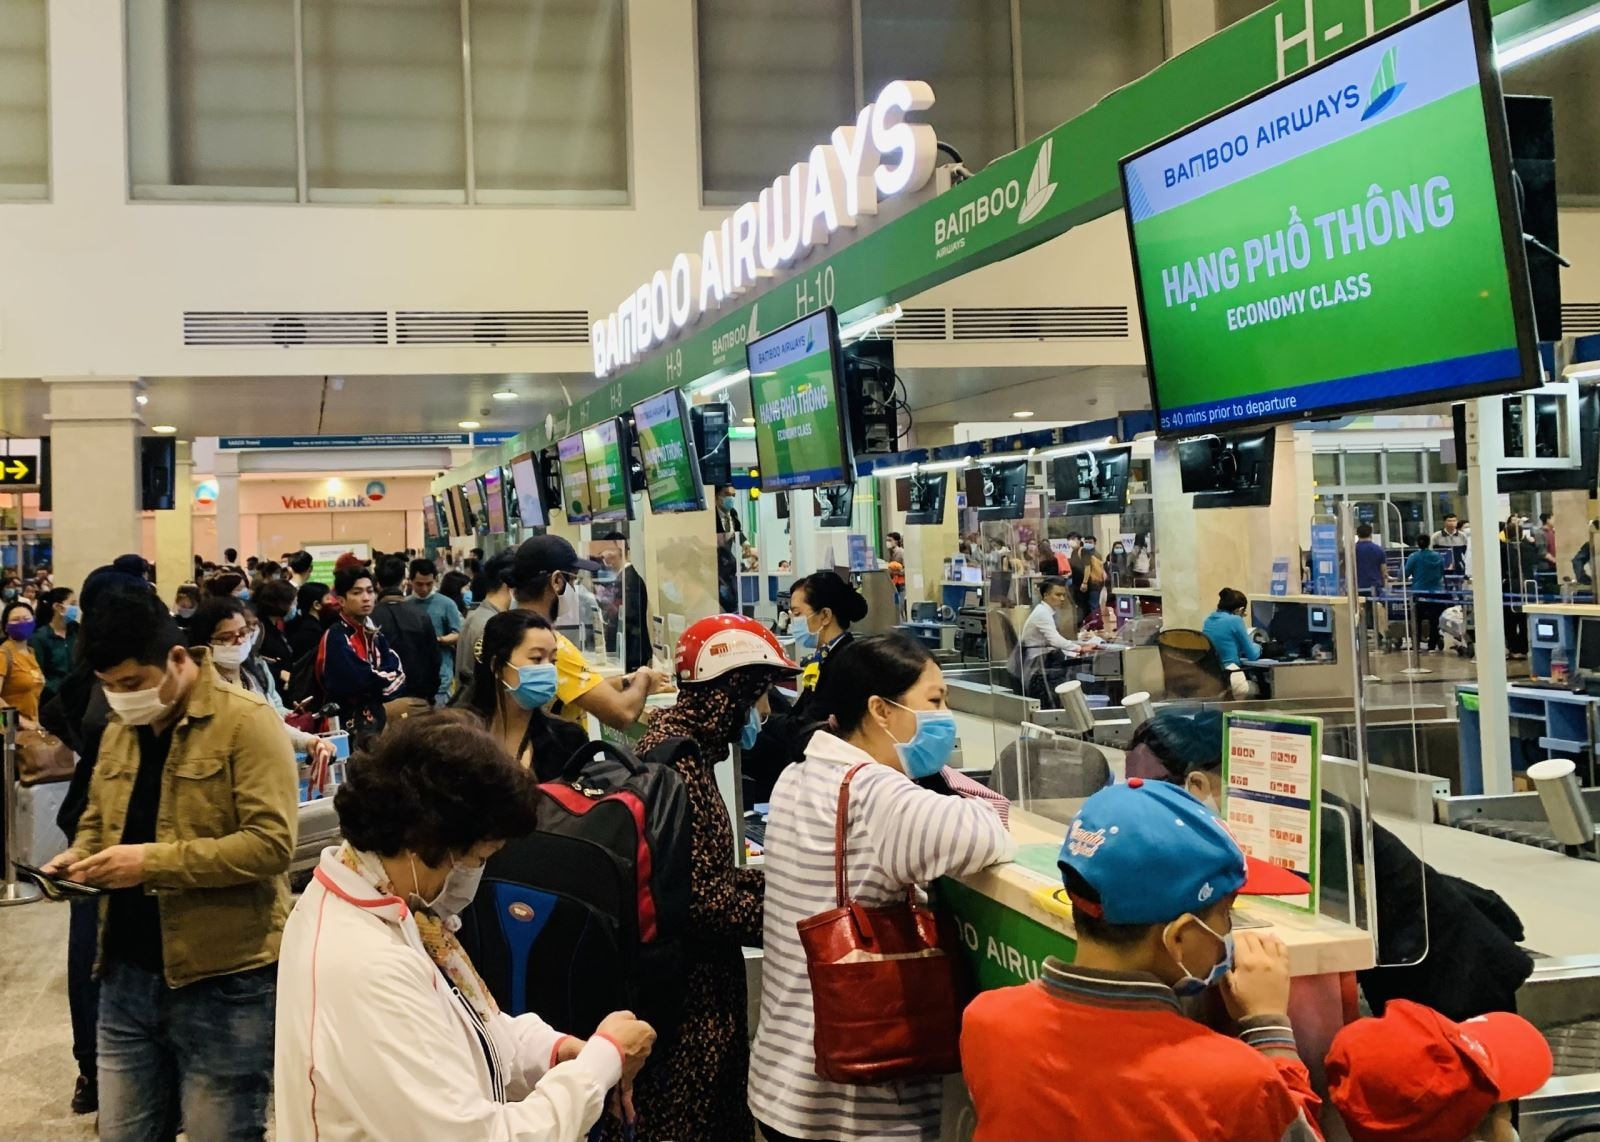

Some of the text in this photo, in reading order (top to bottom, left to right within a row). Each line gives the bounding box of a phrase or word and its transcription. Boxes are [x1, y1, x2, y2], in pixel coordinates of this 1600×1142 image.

[1275, 0, 1420, 80] H-1
[1163, 84, 1361, 189] BAMBOO AIRWAYS
[592, 79, 924, 379] BAMBOO AIRWAYS
[934, 179, 1020, 246] BAMBOO
[935, 237, 966, 260] AIRWAYS
[1162, 175, 1455, 312] HẠNG PHỔ THÔNG
[796, 264, 835, 319] H-10
[1226, 272, 1372, 332] ECONOMY CLASS
[666, 347, 682, 383] H-9
[712, 323, 747, 356] BAMBOO
[1172, 412, 1184, 427] 40
[1185, 408, 1207, 425] mins
[1208, 404, 1231, 424] prior
[1232, 403, 1244, 417] to
[1245, 394, 1297, 417] departure
